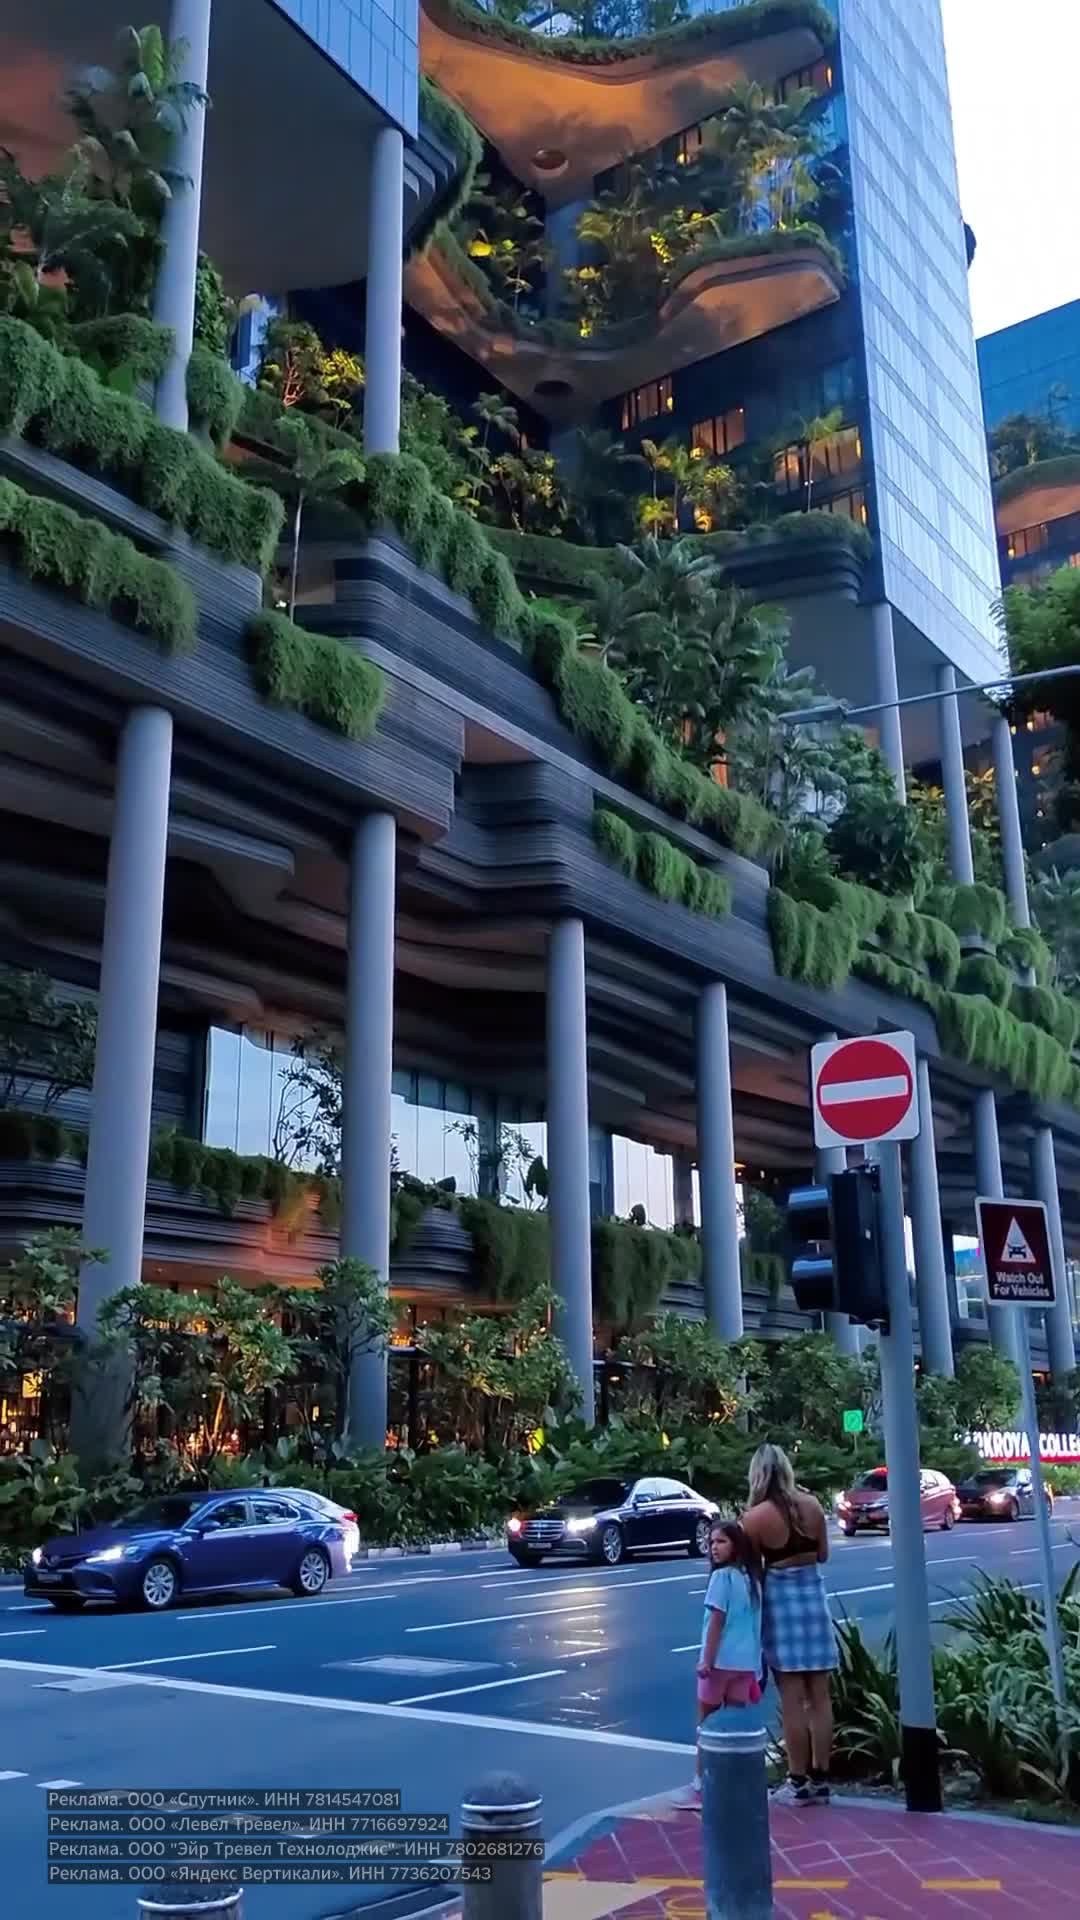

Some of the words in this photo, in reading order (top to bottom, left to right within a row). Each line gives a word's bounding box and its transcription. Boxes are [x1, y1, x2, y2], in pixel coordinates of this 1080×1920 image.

[996, 1271, 1026, 1283] Watch
[1027, 1272, 1044, 1284] Out
[994, 1283, 1010, 1295] For
[1011, 1284, 1050, 1297] Vehicles
